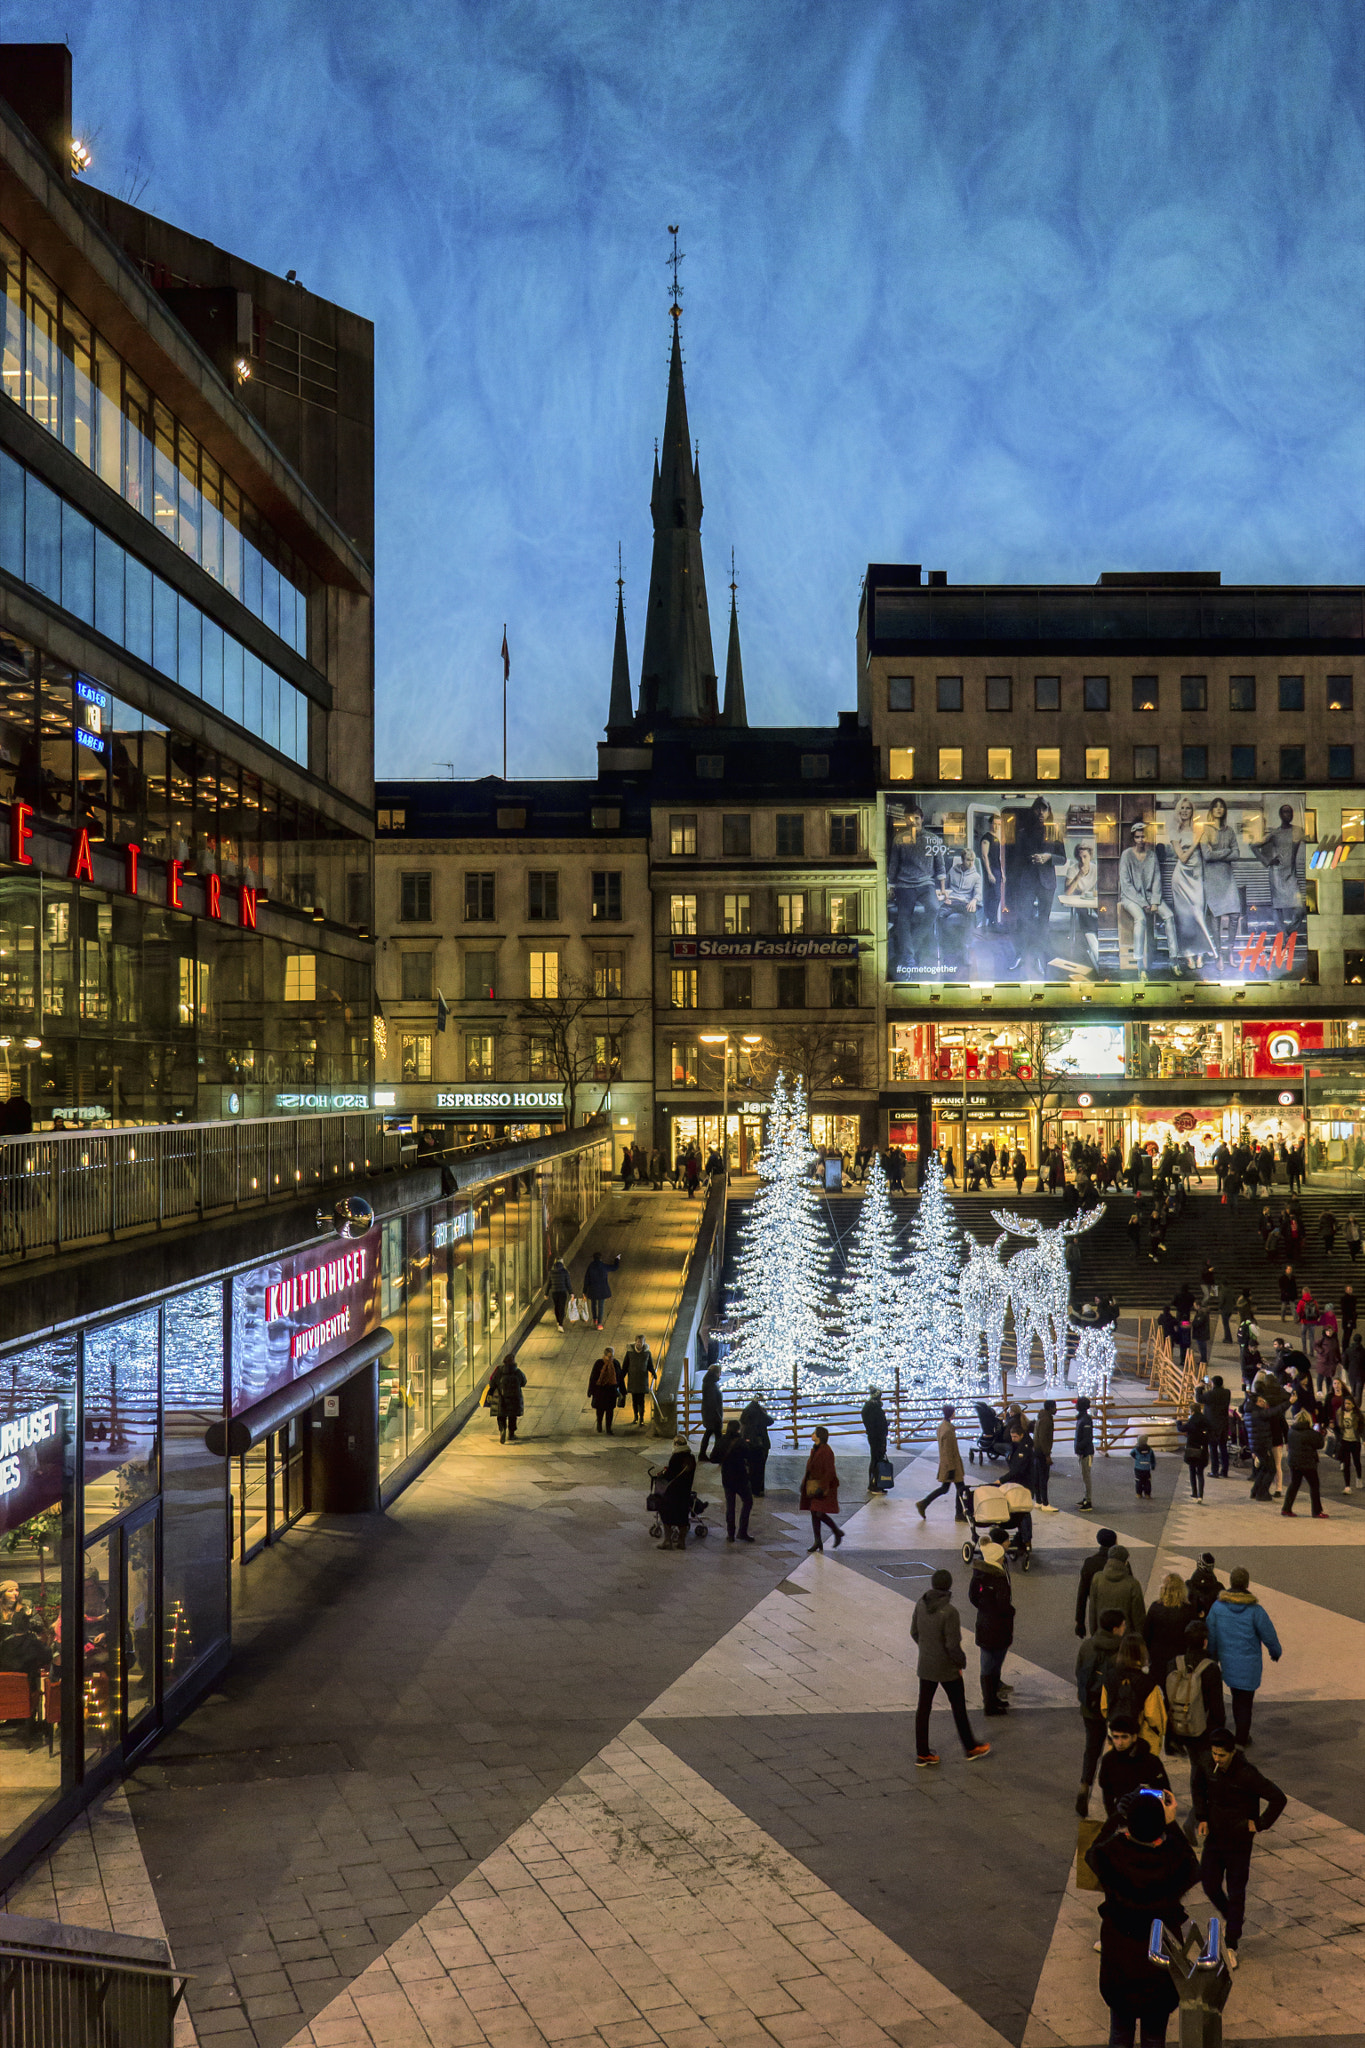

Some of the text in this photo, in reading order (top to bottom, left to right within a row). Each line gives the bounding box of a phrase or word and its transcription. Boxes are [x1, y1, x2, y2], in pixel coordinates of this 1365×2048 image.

[77, 682, 106, 707] TEATER
[10, 802, 257, 930] EATERN
[700, 940, 751, 955] Stena
[754, 939, 856, 957] Fastigheter
[1238, 931, 1298, 973] H&M
[896, 965, 957, 975] #cometogether
[437, 1093, 511, 1107] ESPRESSO
[265, 1248, 366, 1322] KULTURHUSET
[291, 1305, 350, 1358] HUVUDENTRÉ
